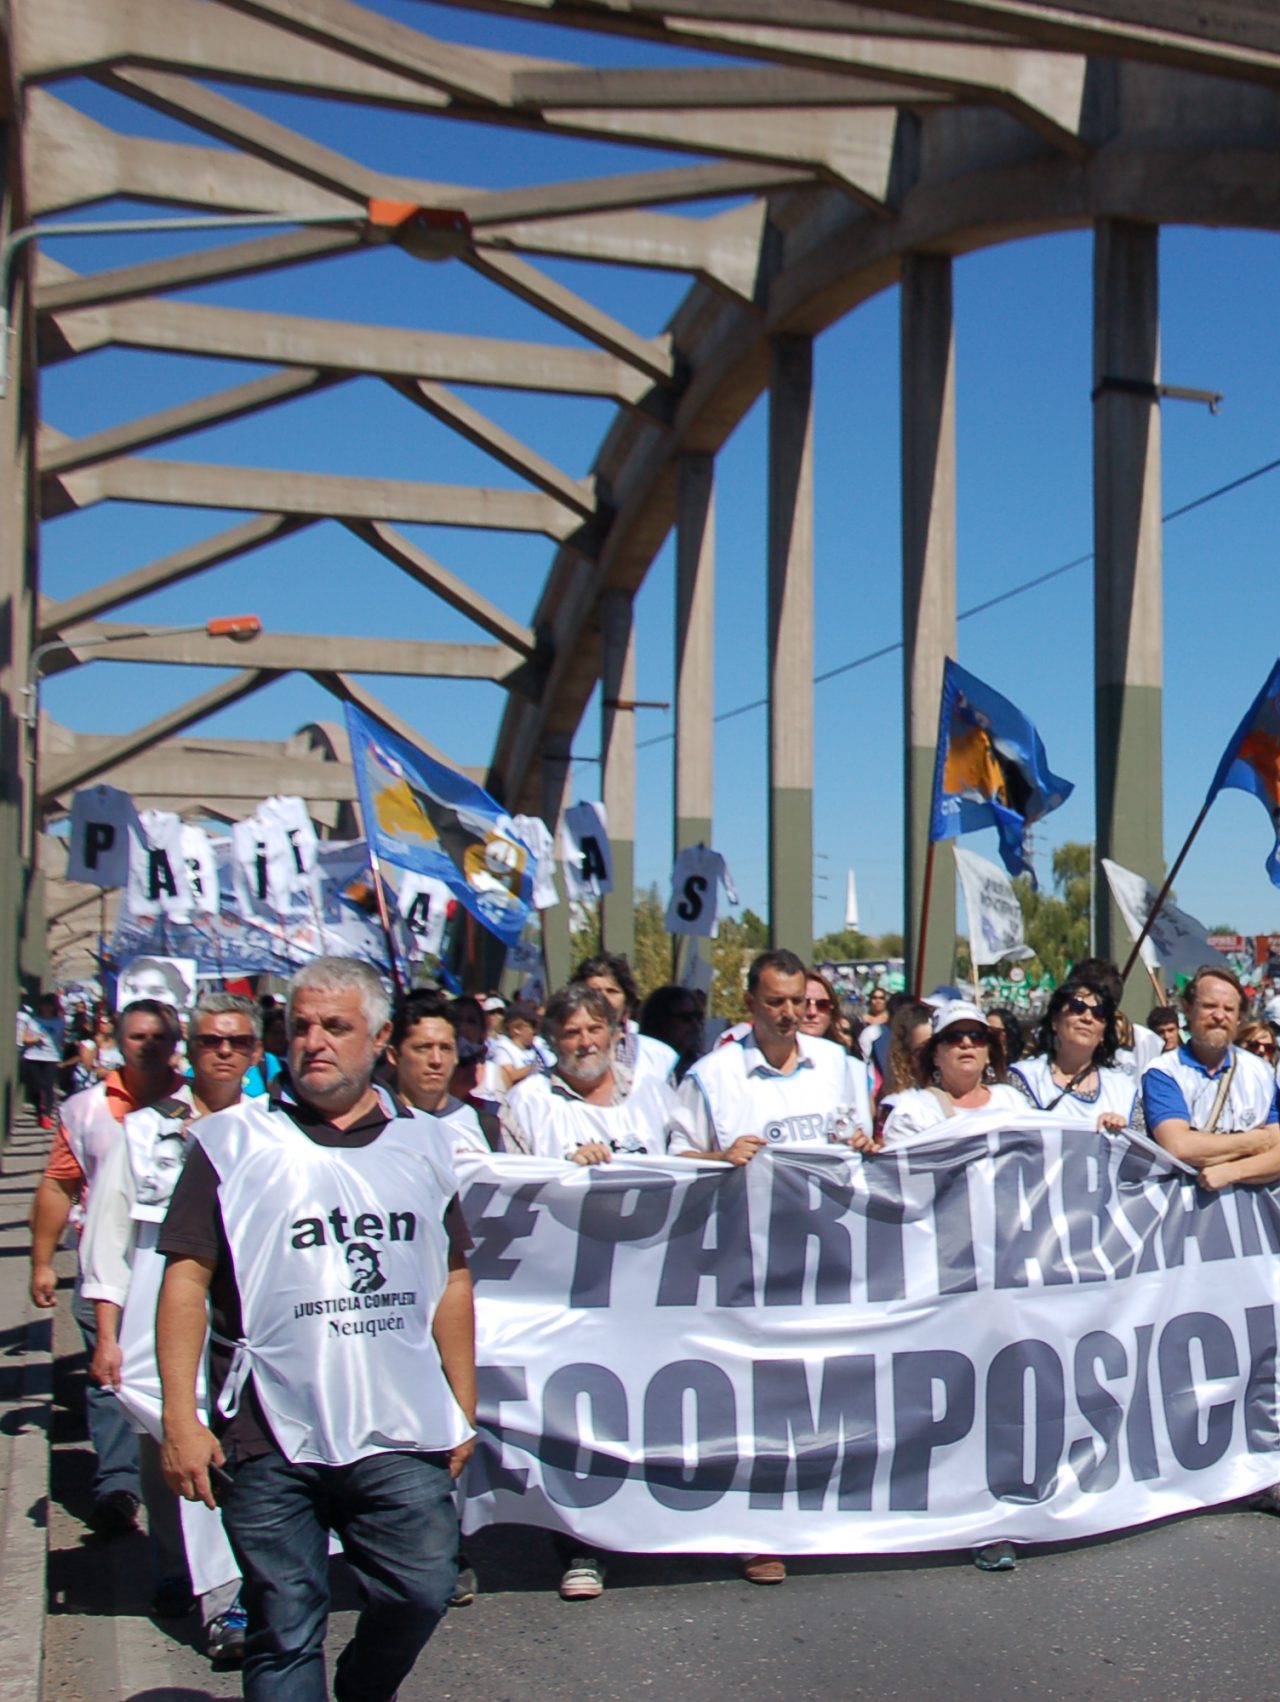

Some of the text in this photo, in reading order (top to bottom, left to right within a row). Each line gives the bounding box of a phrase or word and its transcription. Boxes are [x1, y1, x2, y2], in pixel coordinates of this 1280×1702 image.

[84, 822, 115, 869] P
[579, 835, 608, 882] A
[147, 848, 178, 901] A
[676, 875, 707, 922] S
[291, 1206, 417, 1250] aten
[328, 1312, 405, 1338] Neuquén
